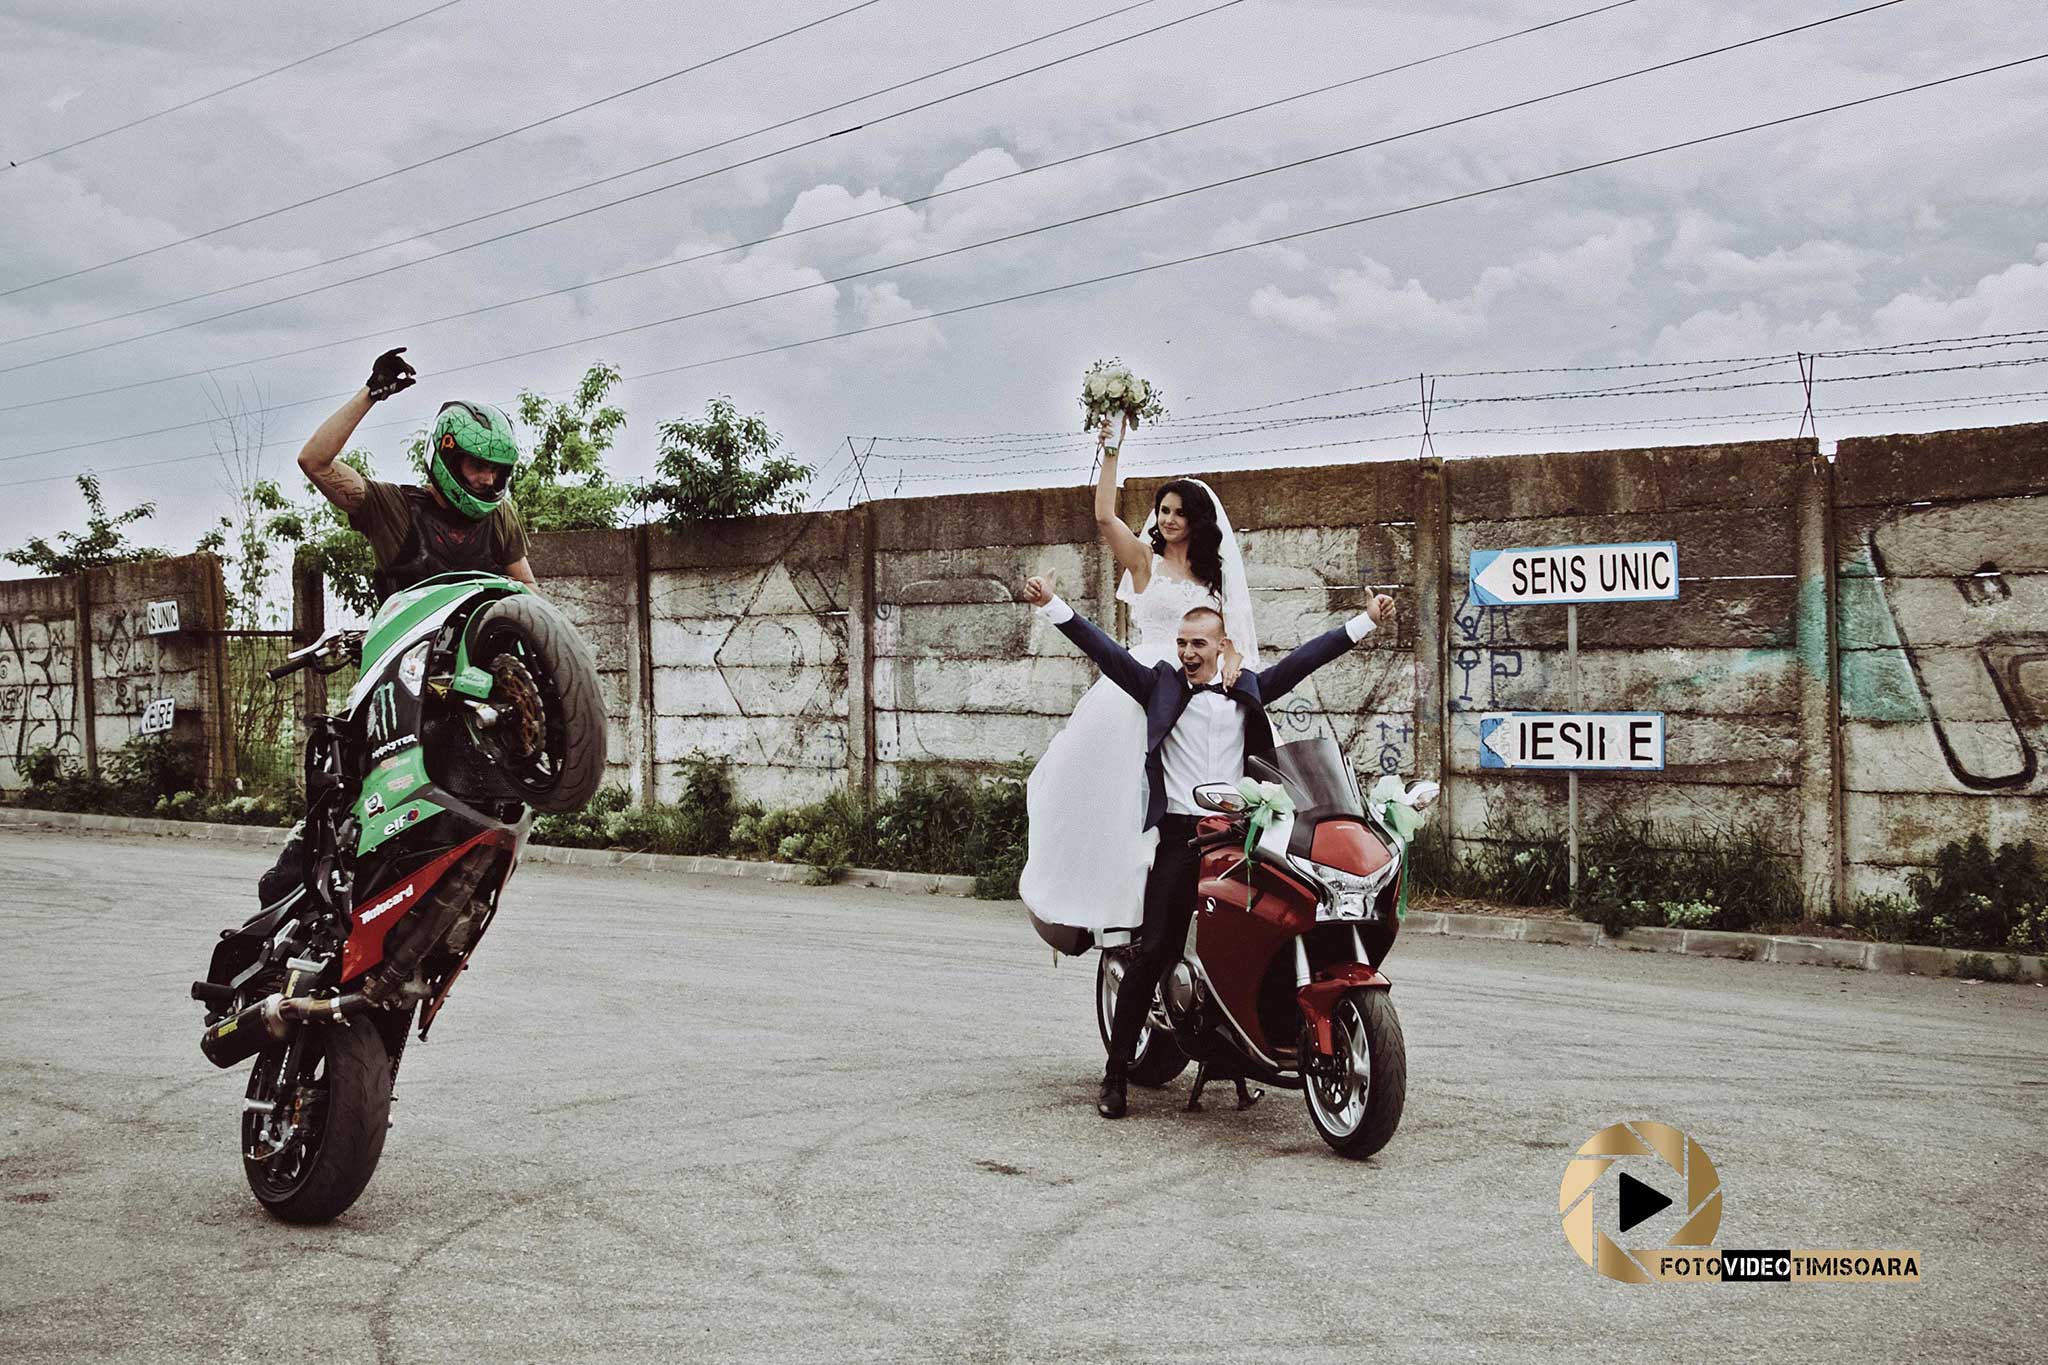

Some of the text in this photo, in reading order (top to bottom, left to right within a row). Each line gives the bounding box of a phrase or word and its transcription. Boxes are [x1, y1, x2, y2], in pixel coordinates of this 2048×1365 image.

[1512, 551, 1671, 596] SENS UNIC
[383, 814, 407, 836] elf
